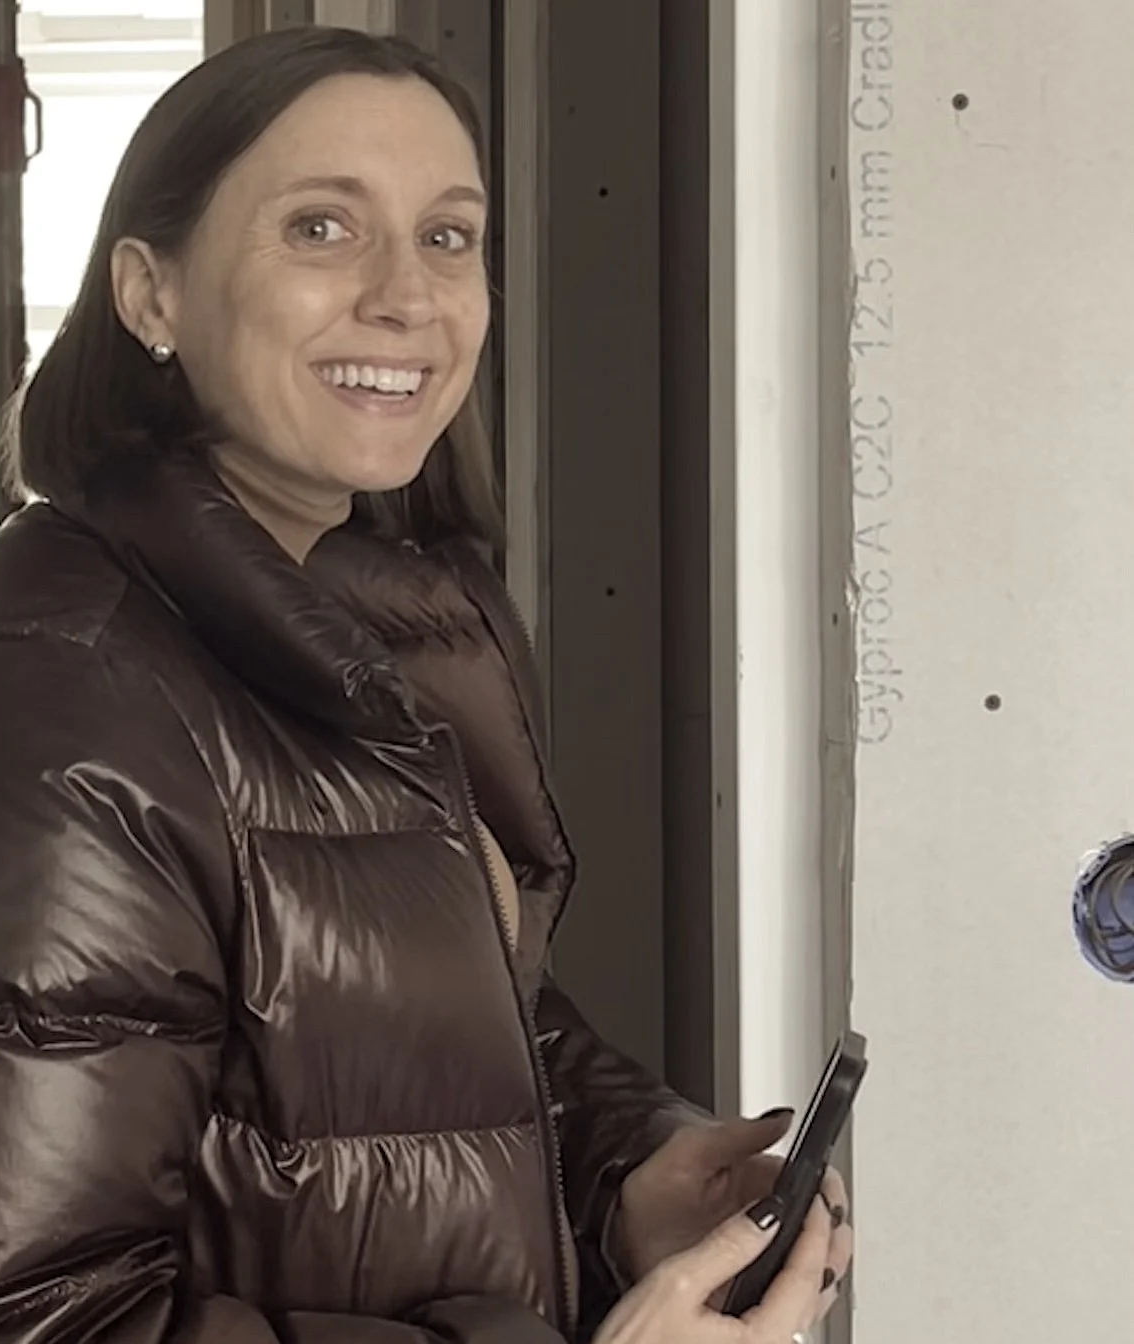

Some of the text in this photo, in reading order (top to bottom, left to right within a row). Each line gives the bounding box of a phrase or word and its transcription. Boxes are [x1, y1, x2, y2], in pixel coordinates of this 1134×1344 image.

[859, 150, 893, 239] mm
[852, 256, 893, 357] 12.5
[851, 394, 893, 500] C2C
[855, 522, 892, 555] A
[856, 570, 902, 745] Gyproc
